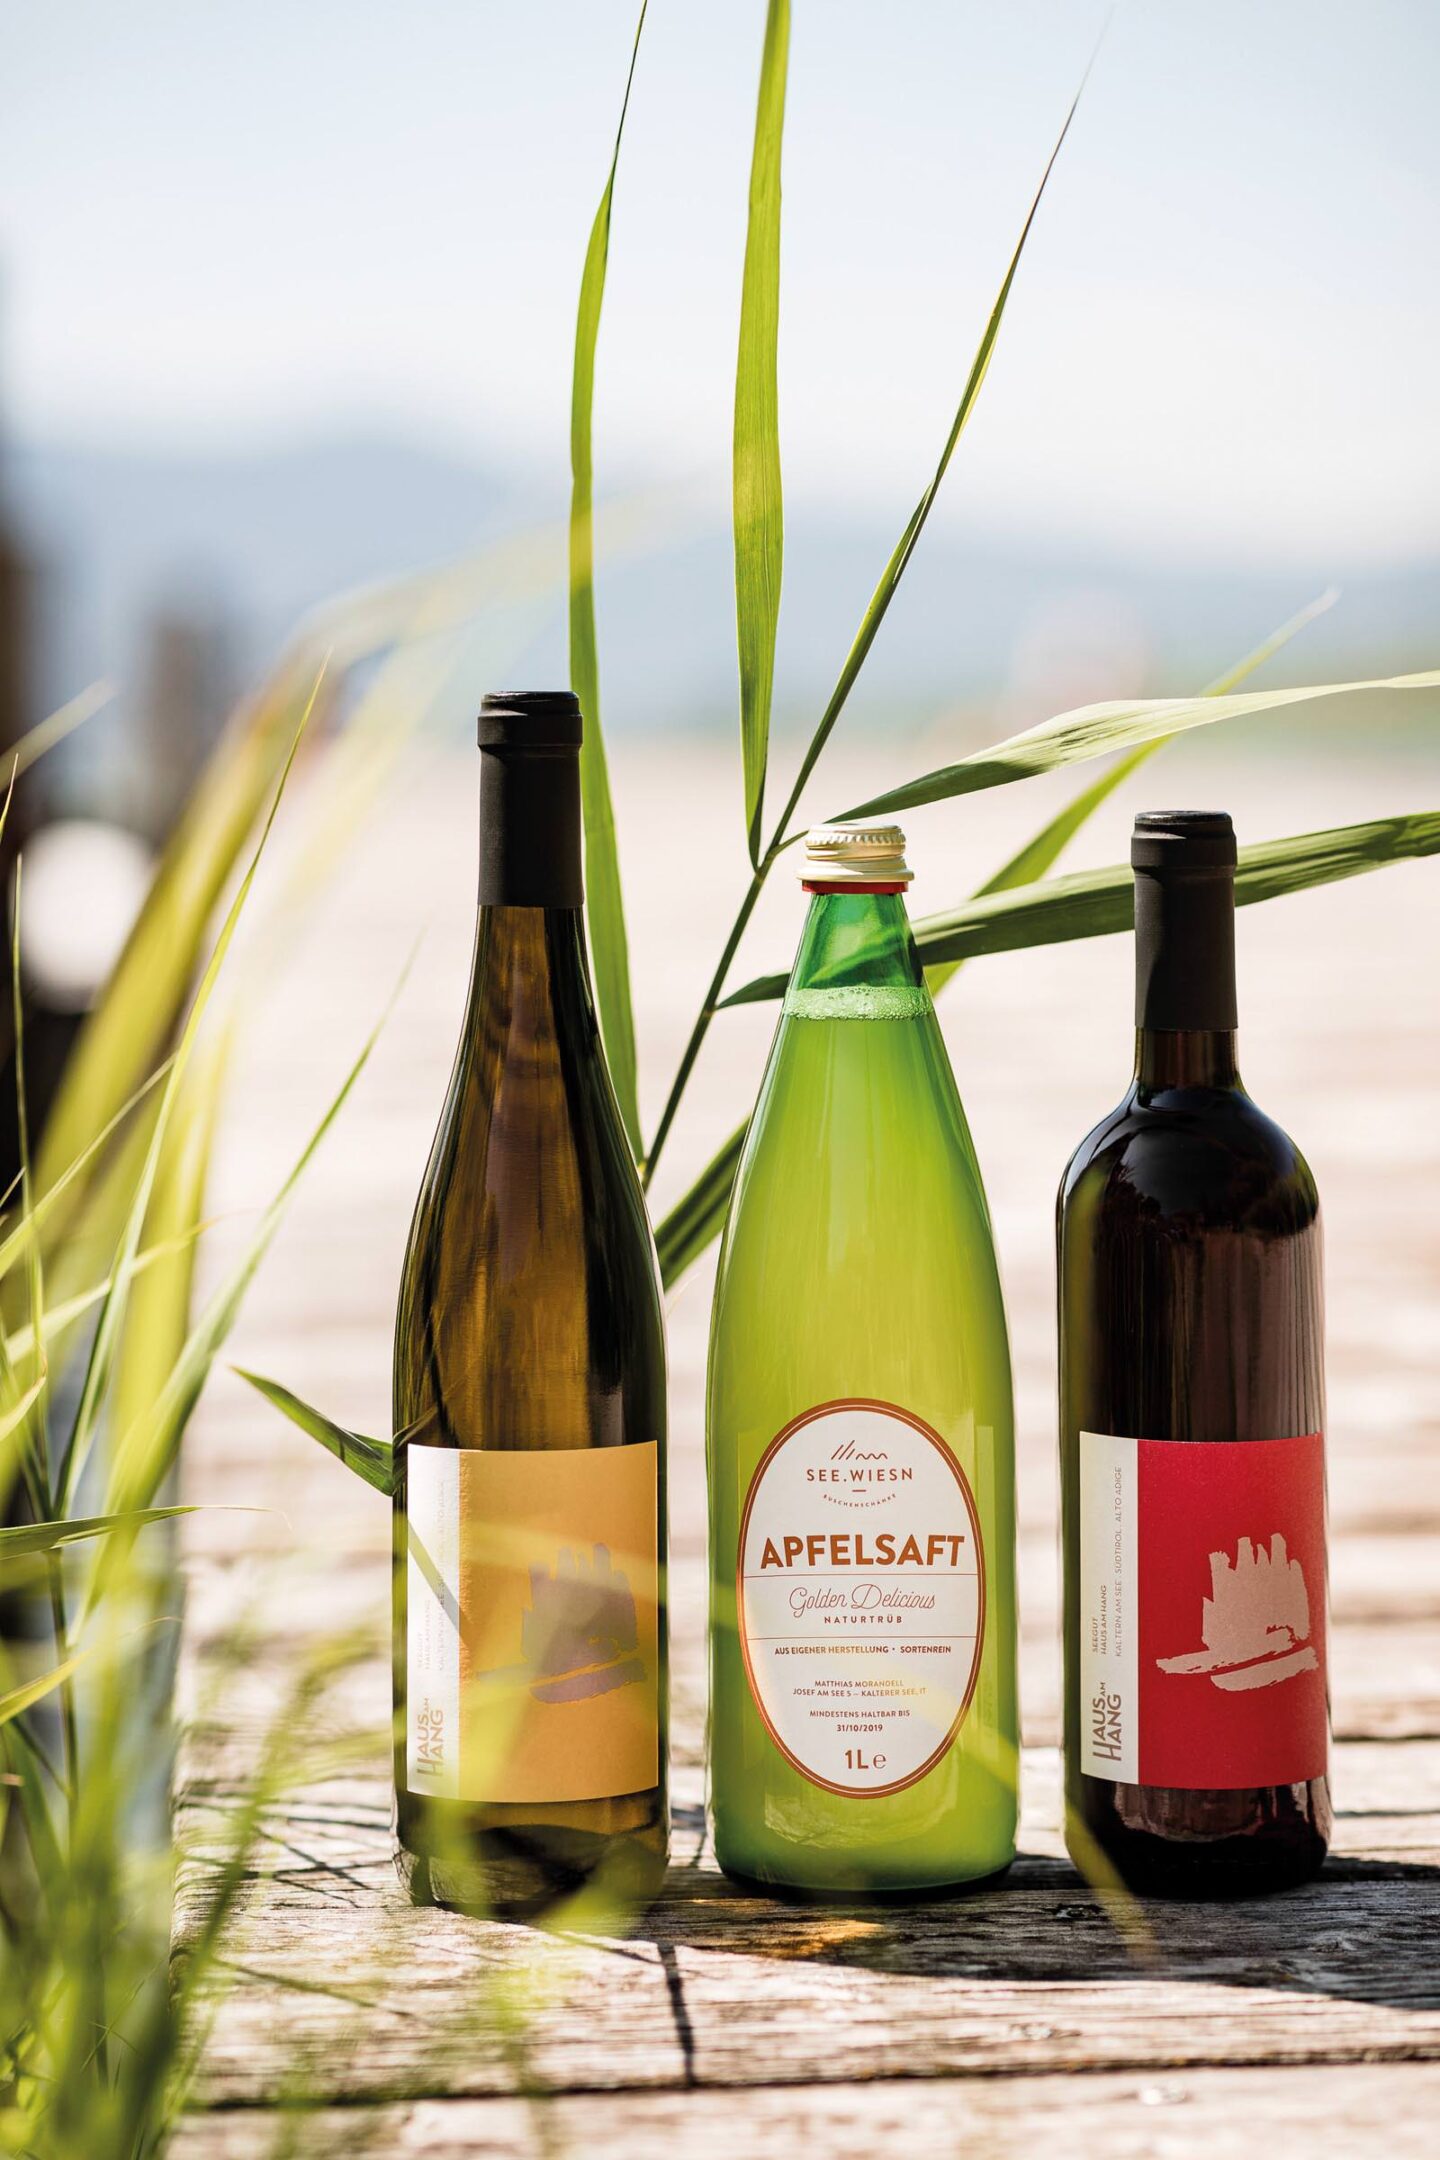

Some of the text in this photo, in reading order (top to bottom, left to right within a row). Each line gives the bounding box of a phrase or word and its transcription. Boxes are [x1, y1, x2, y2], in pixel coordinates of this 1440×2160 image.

[1114, 1466, 1122, 1495] ADIGE
[1114, 1497, 1122, 1522] ALTO
[760, 1533, 965, 1569] APFELSAFT
[789, 1583, 936, 1618] Golden Delicious
[1114, 1599, 1122, 1613] AM
[824, 1614, 903, 1624] NATURTRÜB
[1100, 1614, 1107, 1629] AM
[775, 1647, 790, 1655] AUS
[791, 1646, 826, 1654] EIGENER
[828, 1645, 889, 1654] HERSTELLUNG
[900, 1645, 951, 1653] SORTENREIN
[792, 1688, 815, 1696] JOSEF
[817, 1689, 829, 1697] AM
[861, 1689, 900, 1697] KALTERER
[814, 1680, 904, 1688] MATTHIAS MORANDELL
[809, 1709, 911, 1718] MINDESTENS HALTBAR BIS
[1092, 1681, 1107, 1760] HAUS AM
[836, 1723, 883, 1732] 31/10/2019
[1106, 1694, 1122, 1762] HANG
[417, 1714, 430, 1774] HAUS
[430, 1709, 444, 1777] HANG
